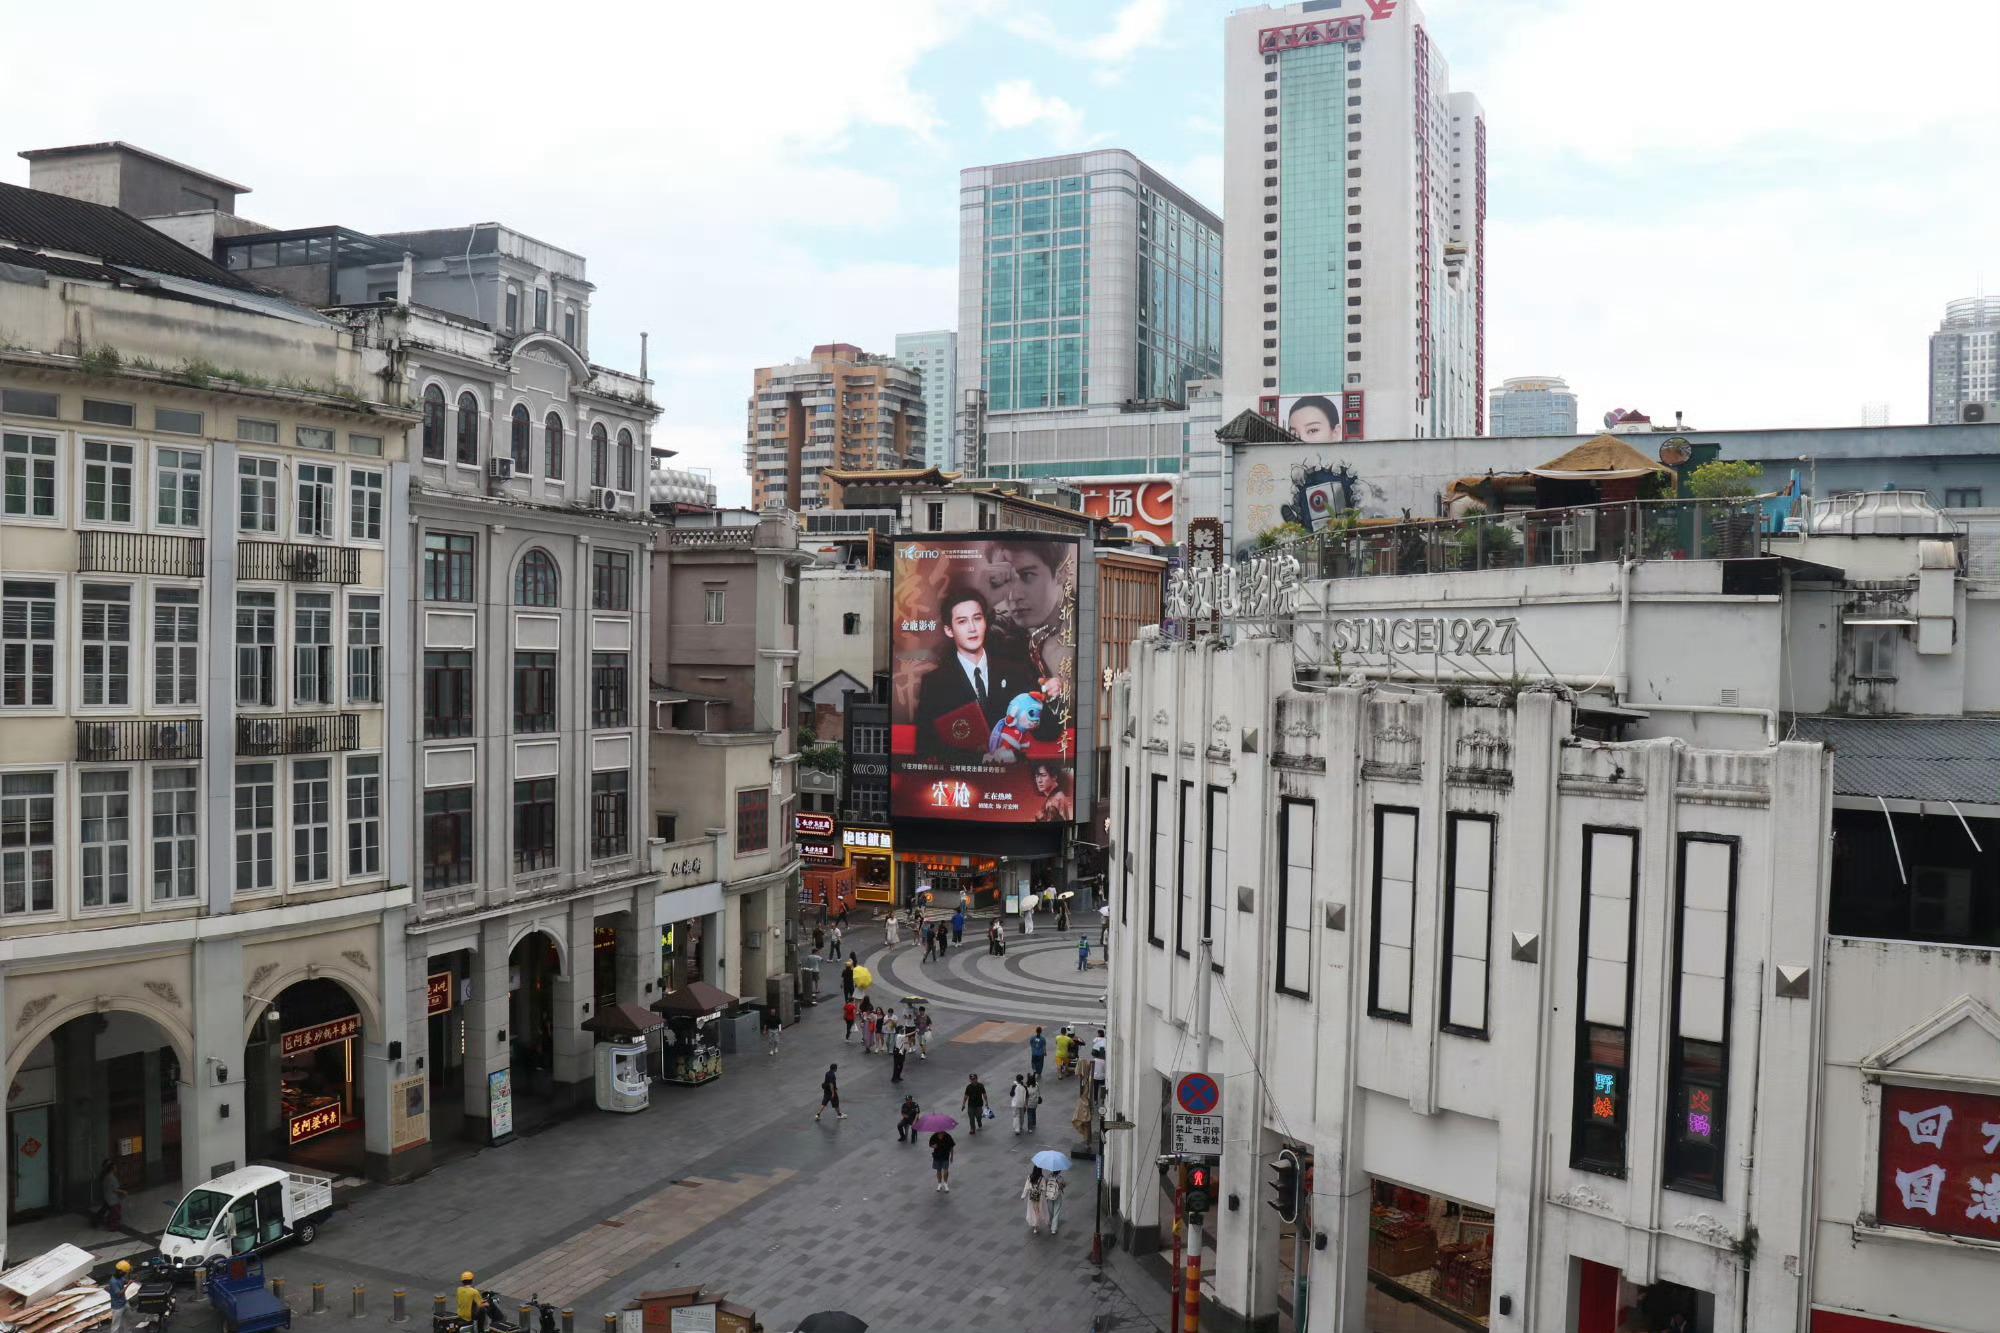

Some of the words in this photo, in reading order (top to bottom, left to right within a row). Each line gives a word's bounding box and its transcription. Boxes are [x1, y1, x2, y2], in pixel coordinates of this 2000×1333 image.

[1165, 554, 1301, 618] 永汉电影院
[931, 781, 970, 808] 空枪
[843, 830, 891, 848] 绝味鱿鱼
[1176, 1125, 1220, 1135] 禁止一切停
